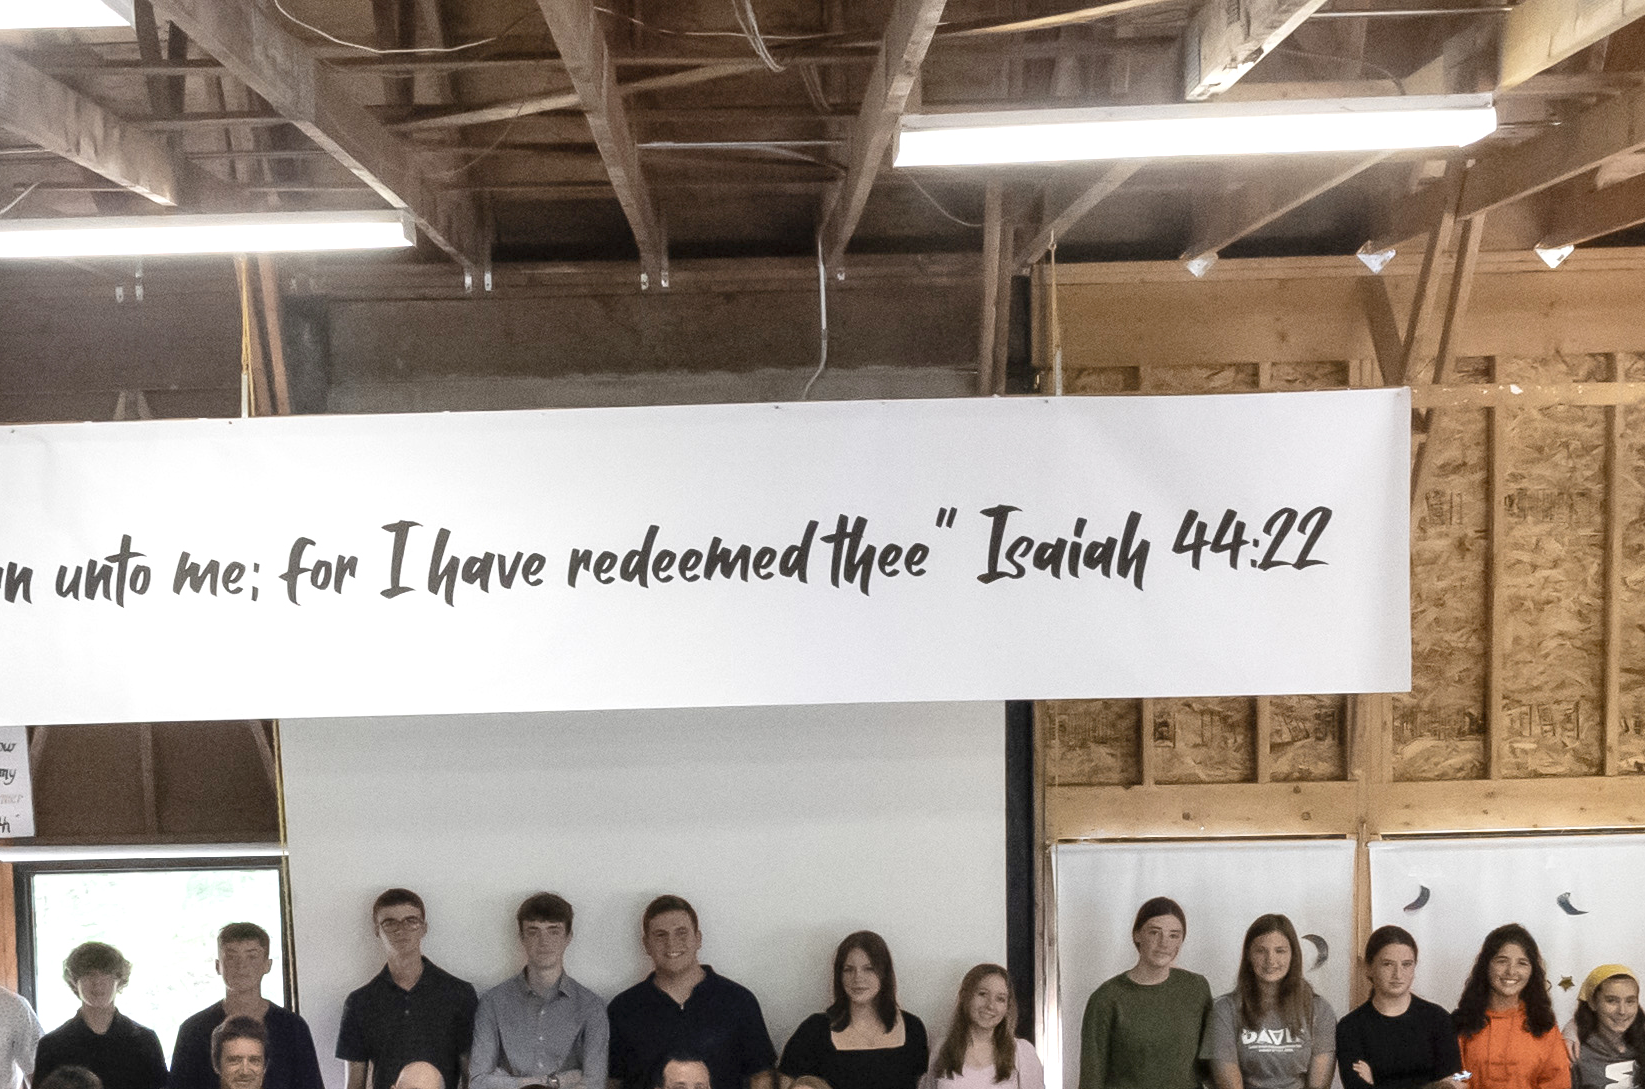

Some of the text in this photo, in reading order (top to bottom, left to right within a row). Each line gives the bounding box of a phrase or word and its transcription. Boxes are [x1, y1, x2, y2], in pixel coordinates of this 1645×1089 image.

[55, 534, 151, 608] unto
[172, 551, 261, 602] me;
[279, 536, 358, 605] for
[380, 520, 422, 599] I
[427, 527, 546, 607] have
[567, 519, 820, 589] redeemed
[820, 506, 958, 597] thee"
[976, 504, 1151, 592] Isaiah
[1171, 506, 1334, 572] 44:22
[1241, 1028, 1305, 1046] DAVI
